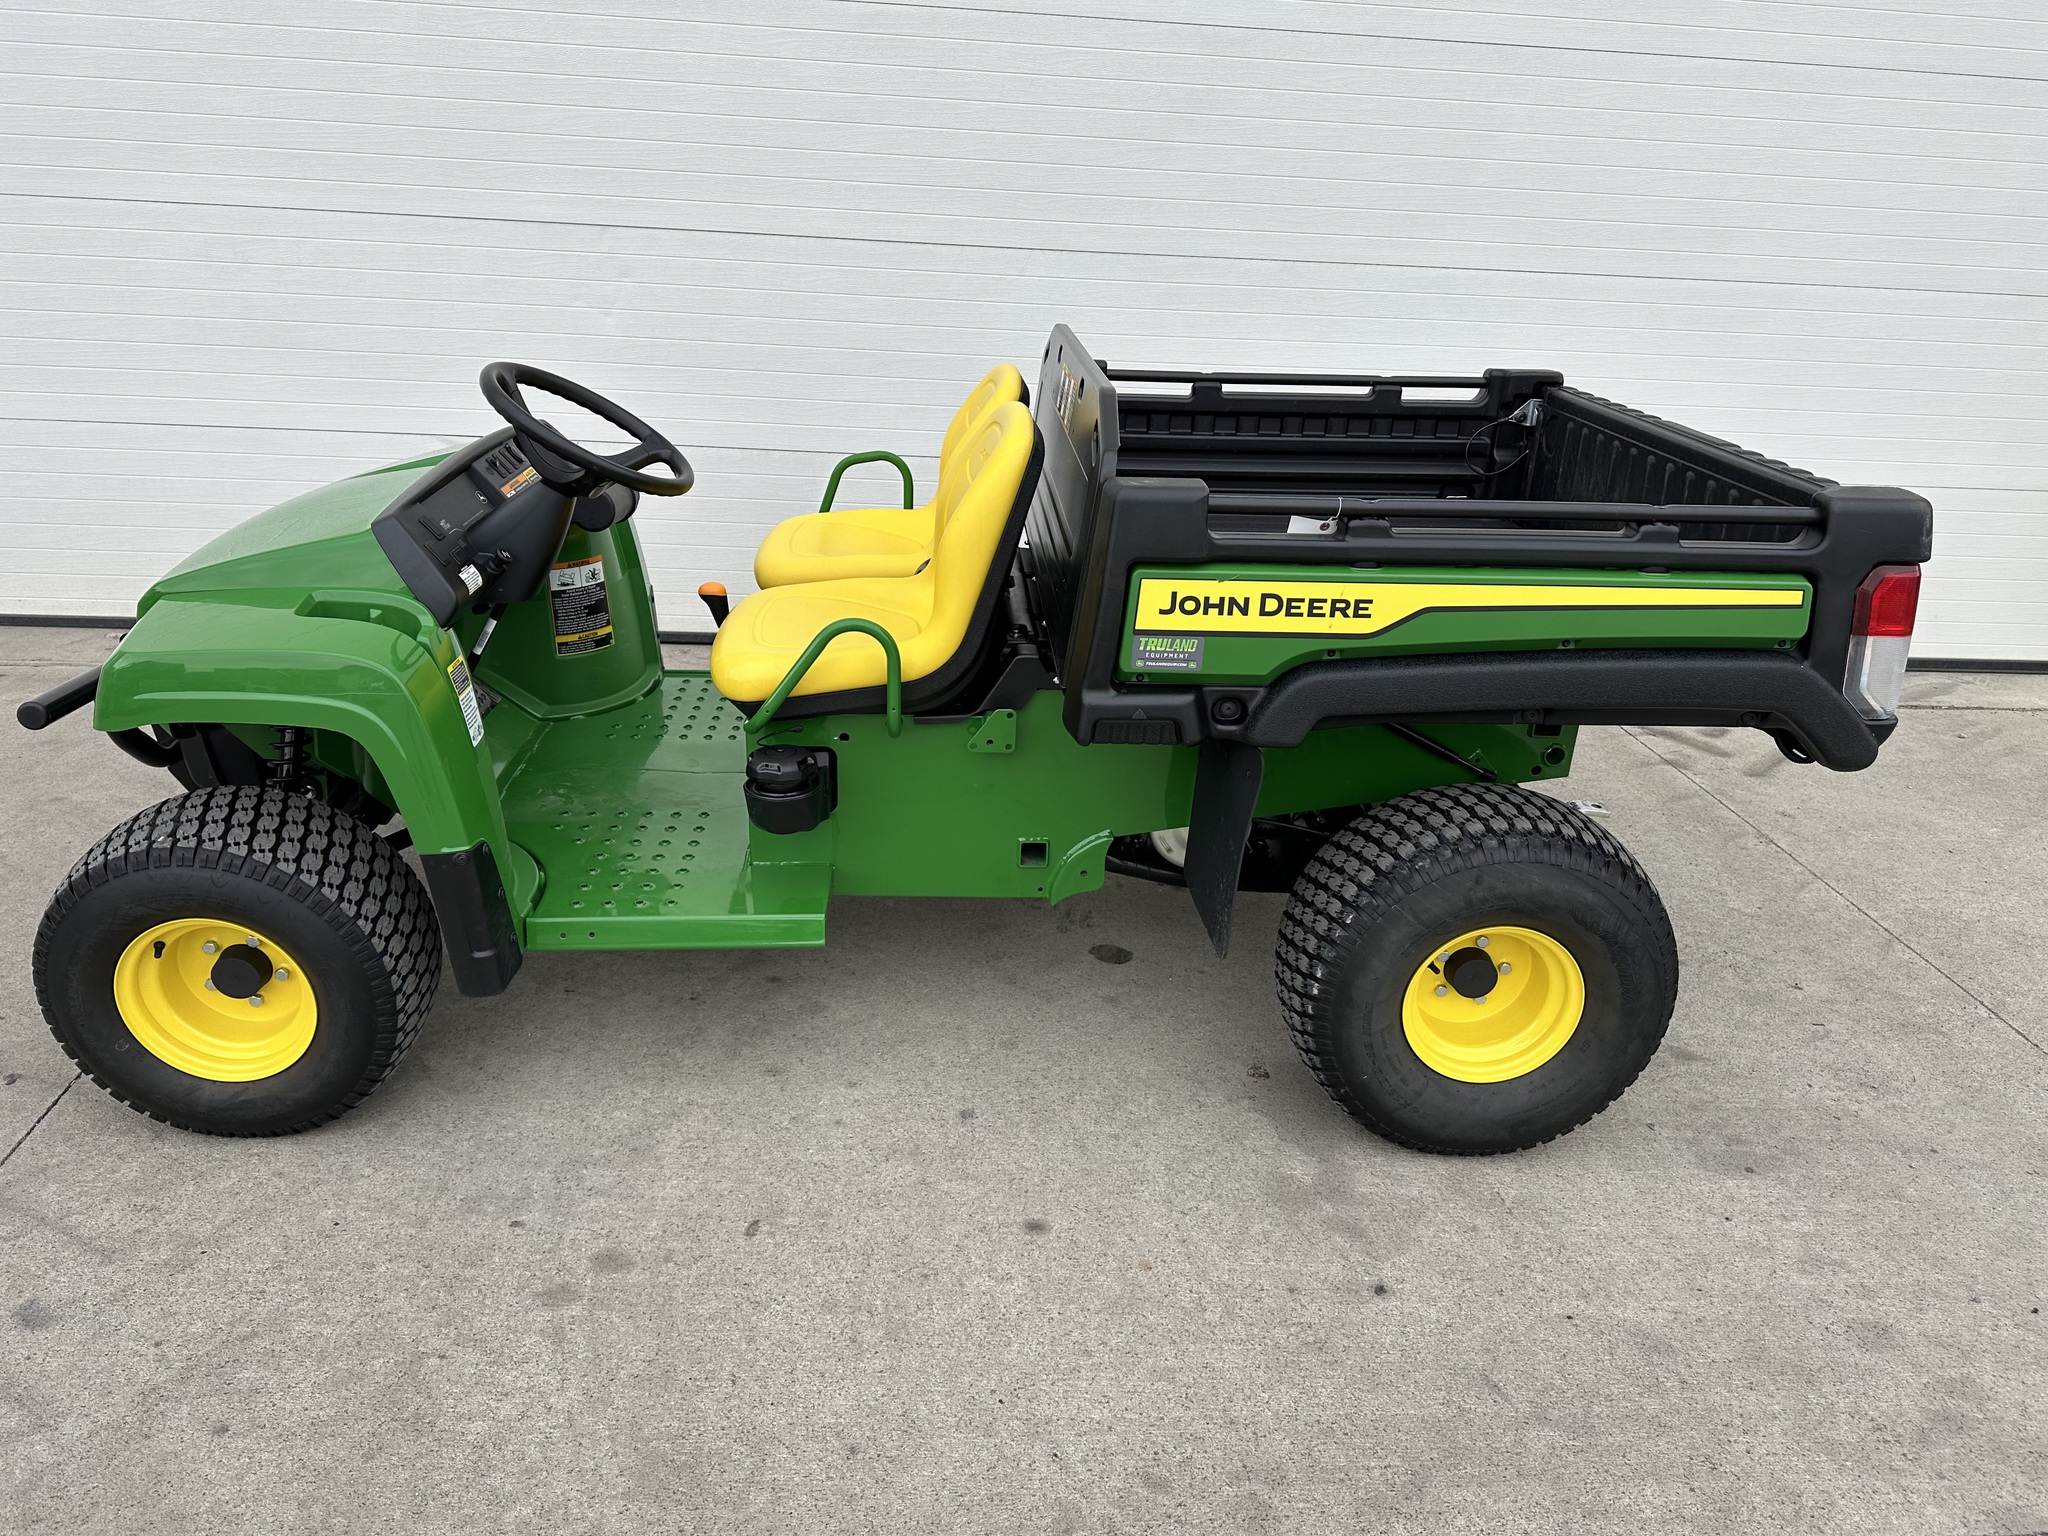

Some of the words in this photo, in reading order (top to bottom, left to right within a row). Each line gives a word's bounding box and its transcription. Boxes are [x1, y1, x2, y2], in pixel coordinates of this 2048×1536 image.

[1158, 591, 1250, 616] JOHN
[1258, 593, 1373, 618] DEERE
[1139, 637, 1198, 652] TRULAND
